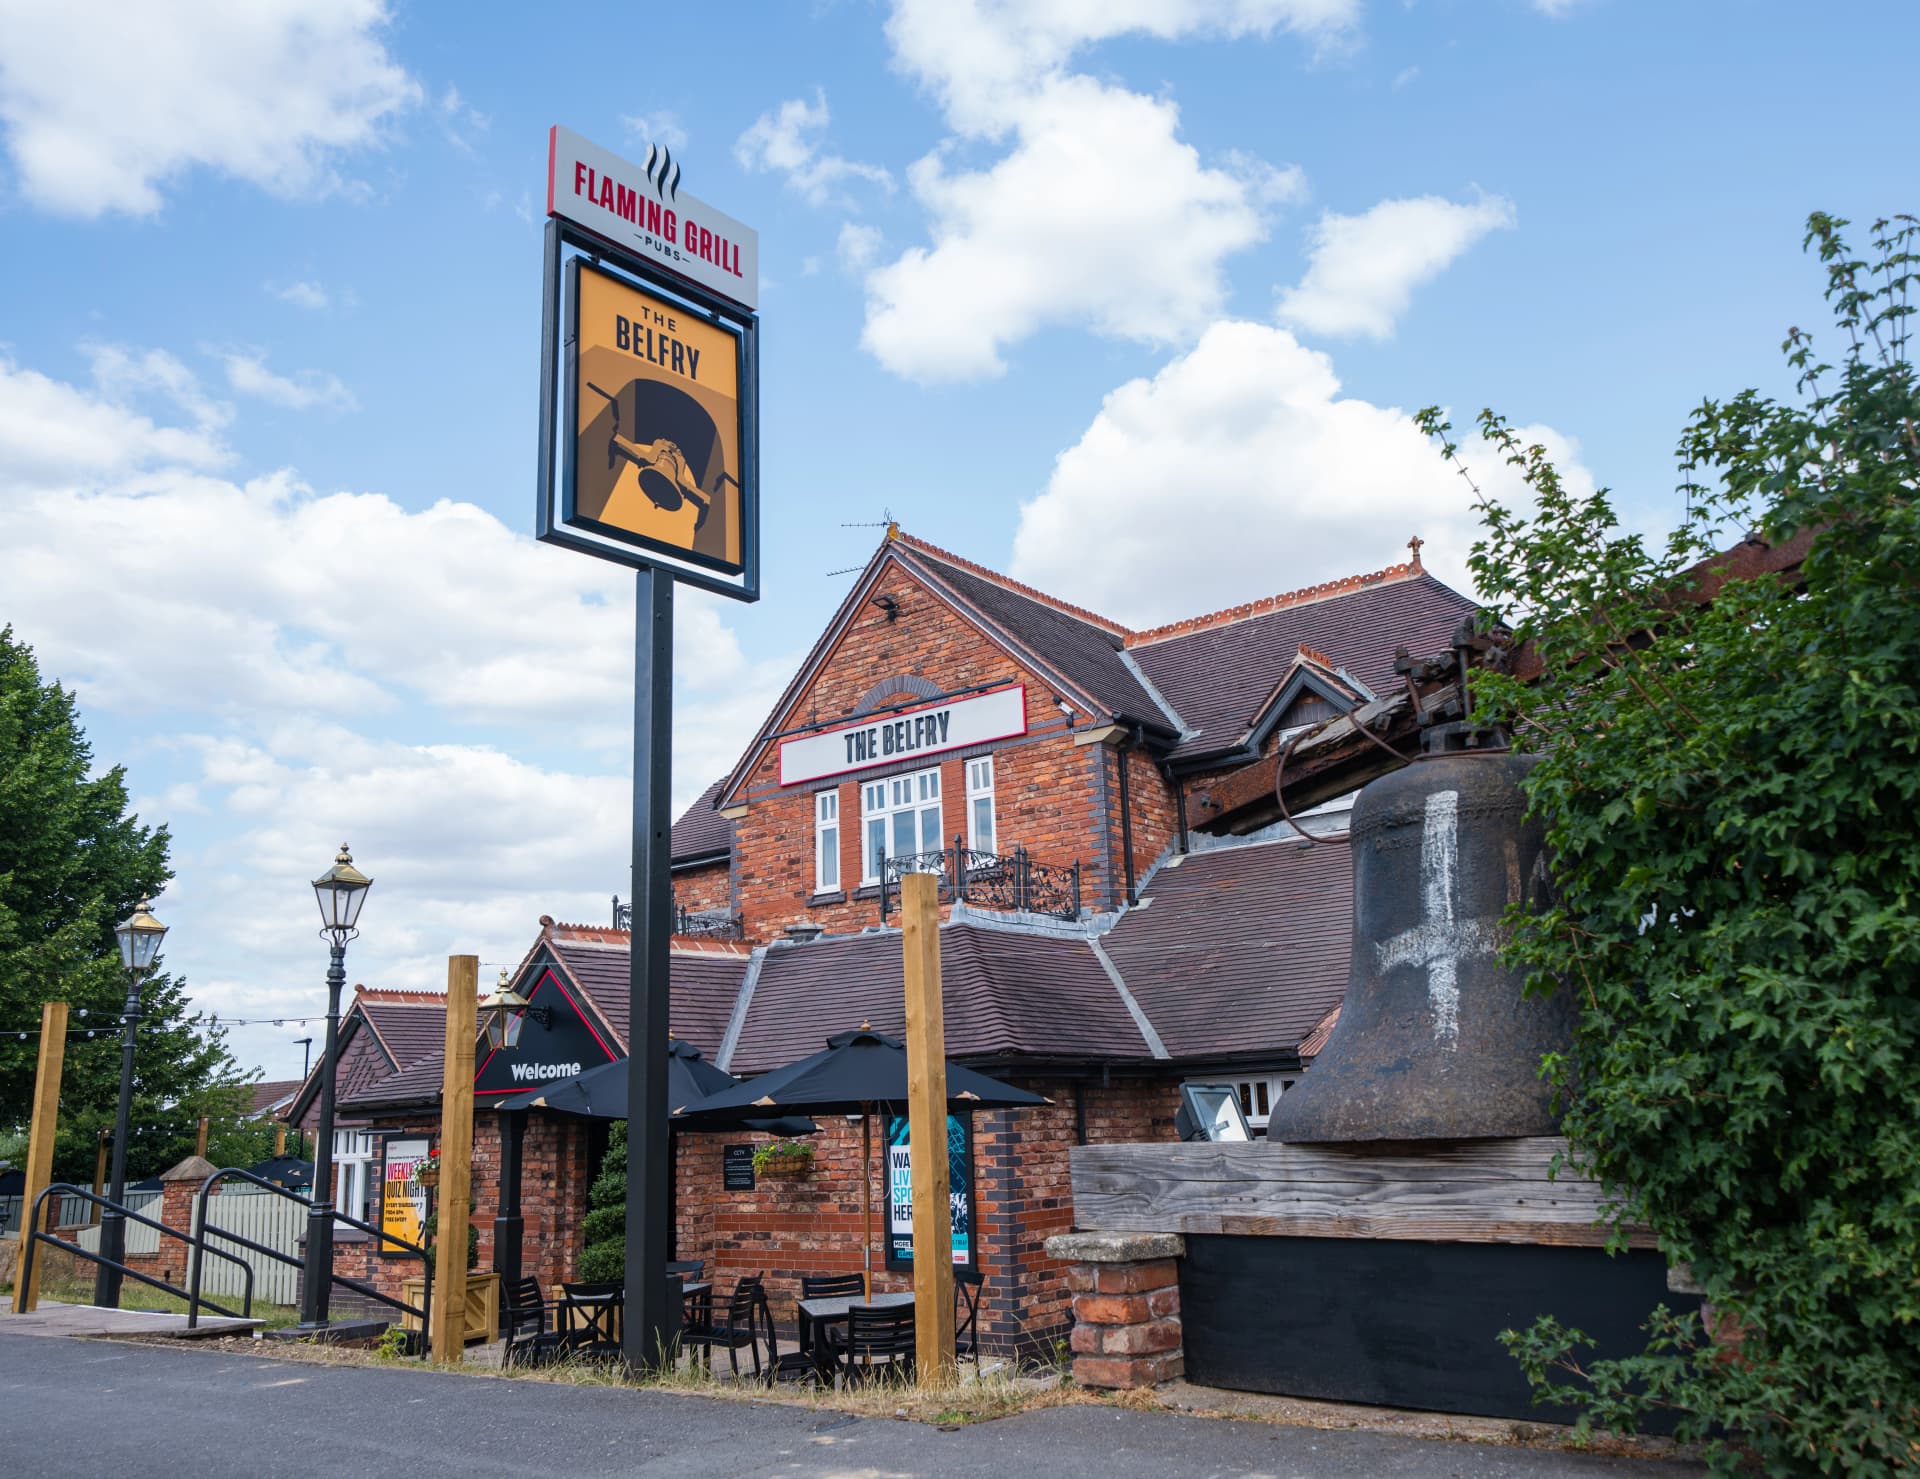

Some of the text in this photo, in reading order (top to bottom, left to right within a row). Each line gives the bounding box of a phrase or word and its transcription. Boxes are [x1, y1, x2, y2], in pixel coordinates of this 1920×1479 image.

[574, 160, 743, 278] FLAMING GRILL
[645, 235, 681, 261] PUBS
[641, 305, 677, 332] THE
[616, 313, 700, 380] BELFRY
[844, 710, 950, 764] THE BELFRY
[511, 1062, 581, 1081] Welcome
[388, 1162, 413, 1180] WEEKLY
[892, 1152, 912, 1168] WA
[386, 1180, 401, 1200] QUIZ
